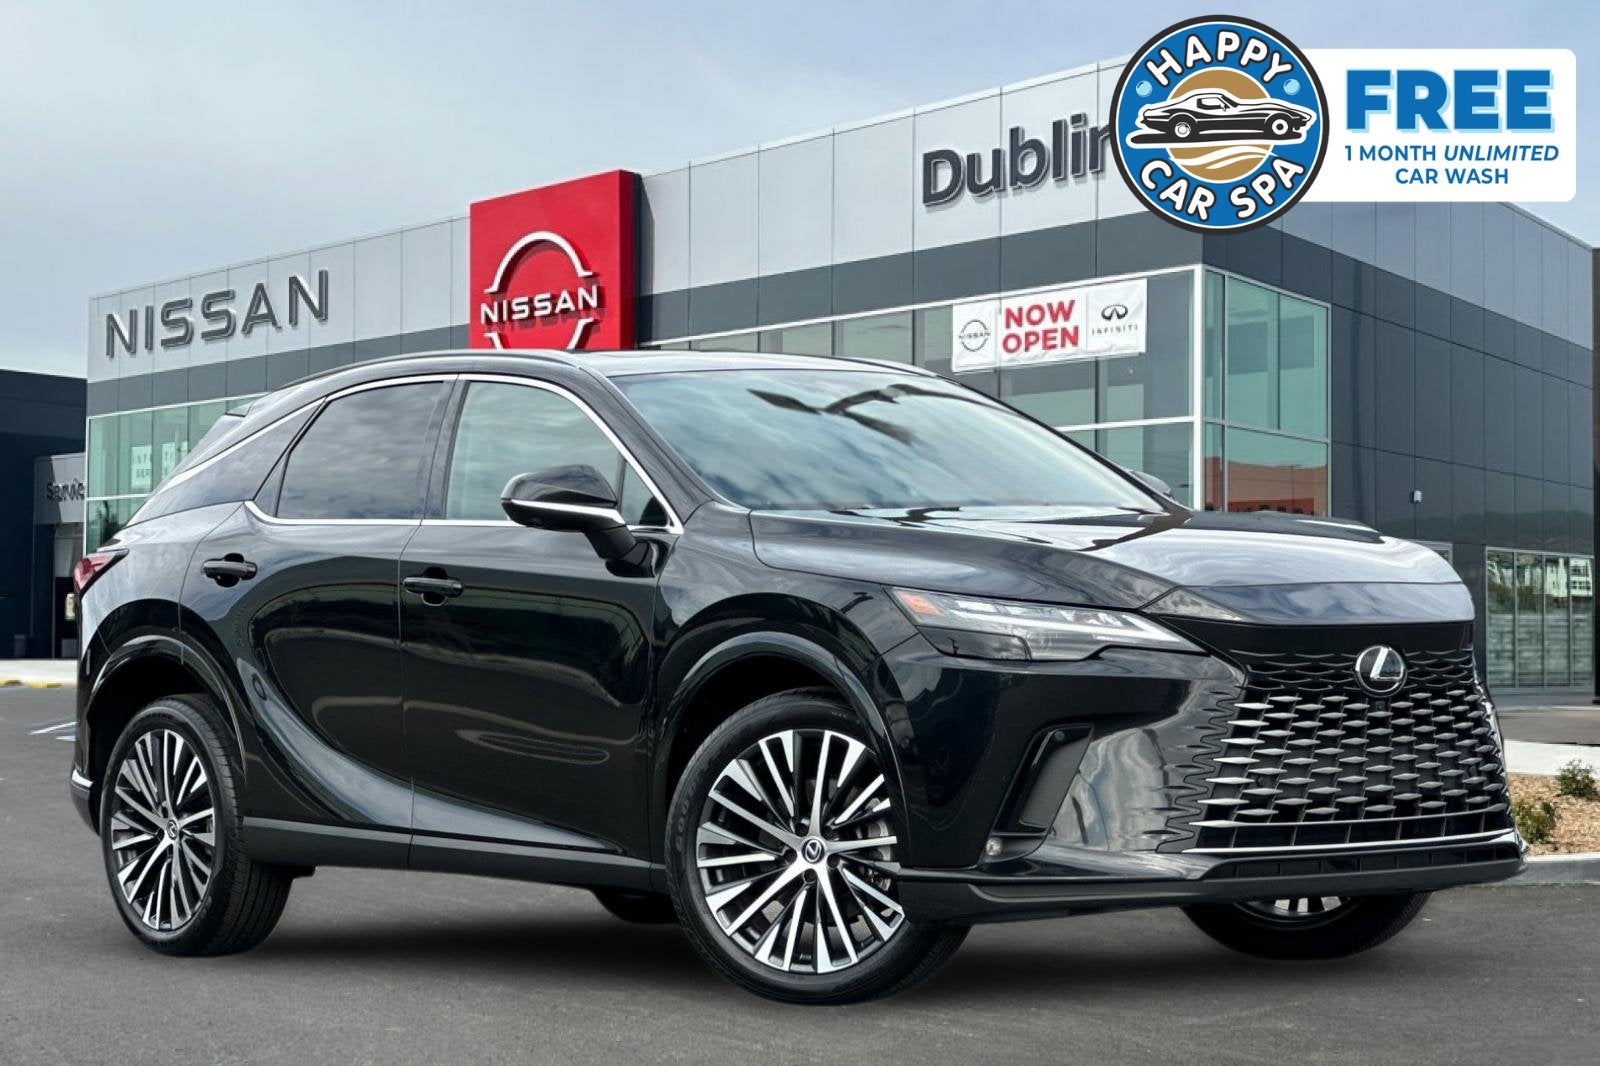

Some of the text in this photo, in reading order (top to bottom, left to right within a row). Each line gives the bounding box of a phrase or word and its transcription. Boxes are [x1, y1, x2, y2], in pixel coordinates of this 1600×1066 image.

[105, 269, 329, 359] NISSAN
[480, 284, 598, 325] NISSAN
[1004, 300, 1076, 330] NOW
[958, 331, 991, 341] NISSAN
[1002, 325, 1080, 354] OPEN
[1091, 324, 1139, 337] INFINITI
